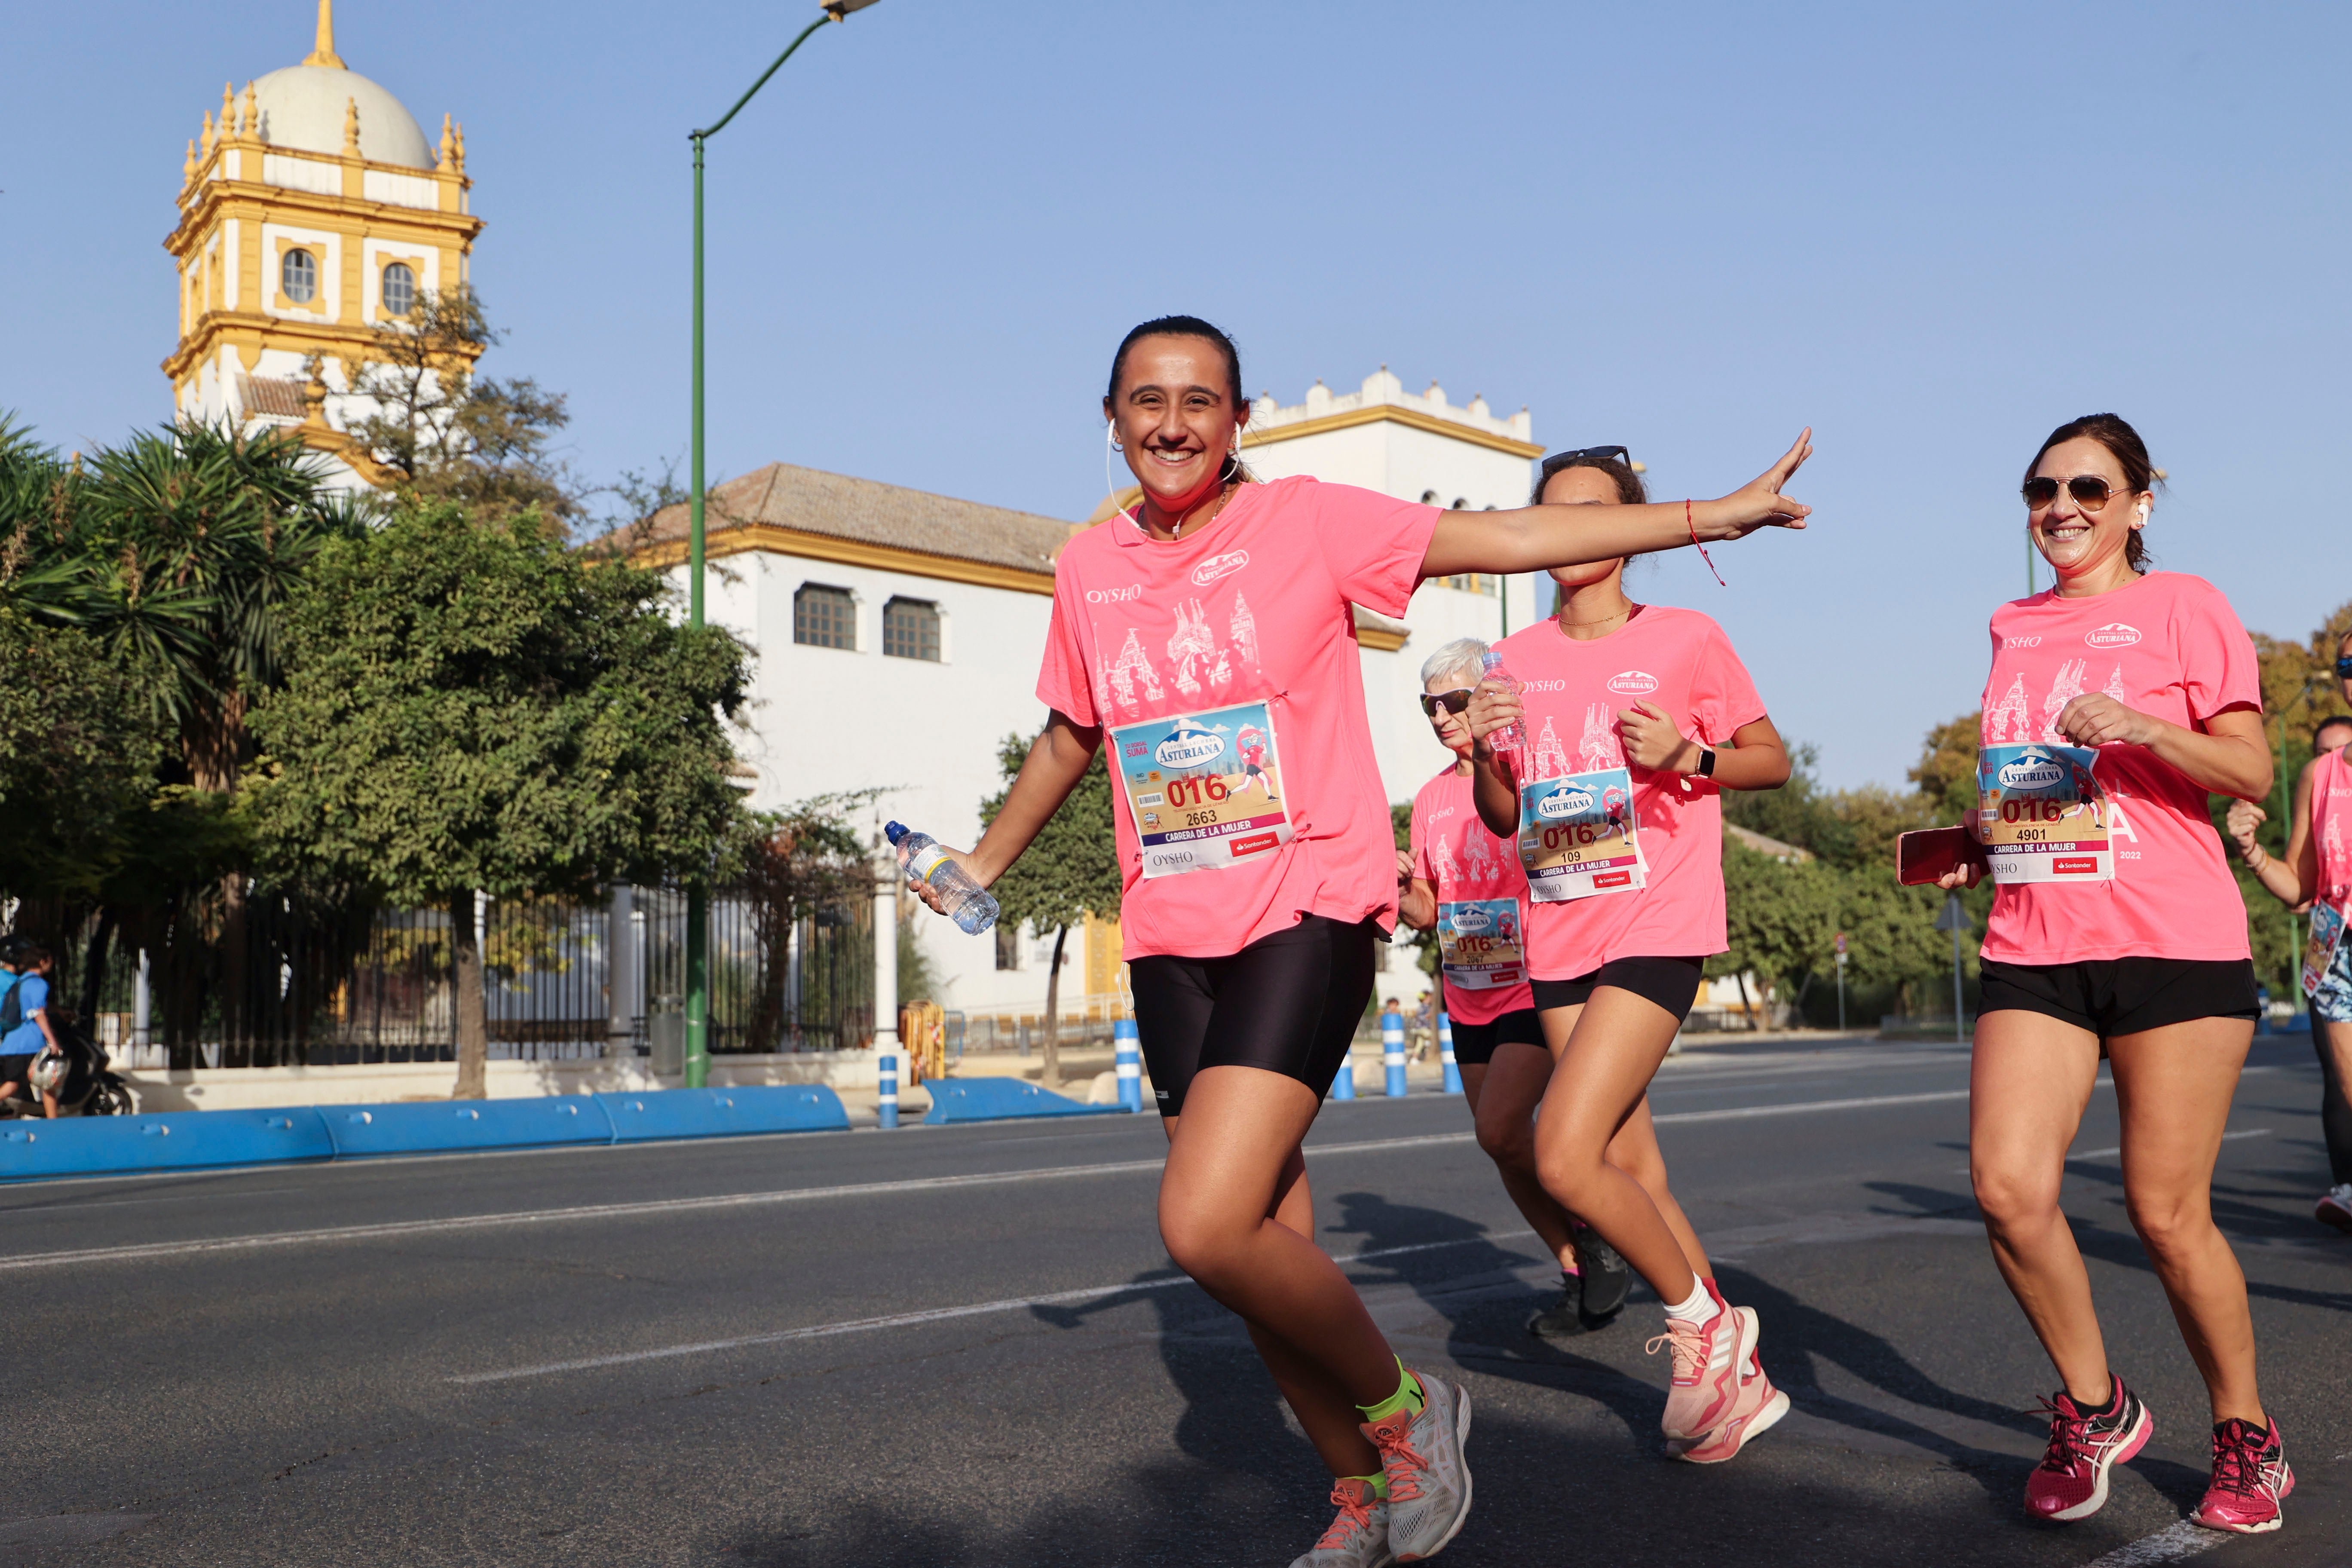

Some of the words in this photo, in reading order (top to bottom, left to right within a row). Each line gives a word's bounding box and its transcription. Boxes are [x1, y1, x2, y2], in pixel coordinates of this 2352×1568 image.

[1086, 584, 1141, 604] OYSHO
[2002, 636, 2042, 649] YSHO
[2089, 633, 2136, 643] ASTURIANA
[1611, 680, 1654, 689] ASTURIANA
[1189, 738, 1216, 746] LECHERA
[1126, 747, 1148, 758] SUMA
[1160, 743, 1221, 763] ASTURIANA
[2002, 770, 2061, 783] ASTURIANA
[1167, 774, 1228, 808] 016
[1541, 799, 1590, 814] ASTURIANA
[2003, 797, 2061, 824] 016
[1186, 810, 1217, 826] 2663
[1429, 806, 1454, 824] OSHO
[1165, 830, 1196, 842] CARRERA
[1196, 828, 1207, 837] DE
[1208, 825, 1220, 836] LA
[1221, 820, 1252, 833] MUJER
[1544, 822, 1593, 849] 016
[2017, 829, 2046, 841] 4901
[1243, 838, 1272, 849] Santander
[1994, 845, 2023, 854] CARRERA
[2024, 844, 2034, 852] DE
[2037, 843, 2047, 852] LA
[2049, 842, 2076, 851] MUJER
[1153, 851, 1193, 867] OYSHO
[1561, 851, 1581, 863] 109
[2120, 851, 2141, 859] 2022
[1540, 867, 1565, 877] CARRERA
[1566, 865, 1574, 873] DE
[1576, 864, 1585, 872] LA
[1586, 860, 1611, 870] MUJER
[1537, 884, 1561, 894] OYSHO
[1454, 918, 1488, 926] ASTURIANA
[1457, 936, 1491, 952] 016
